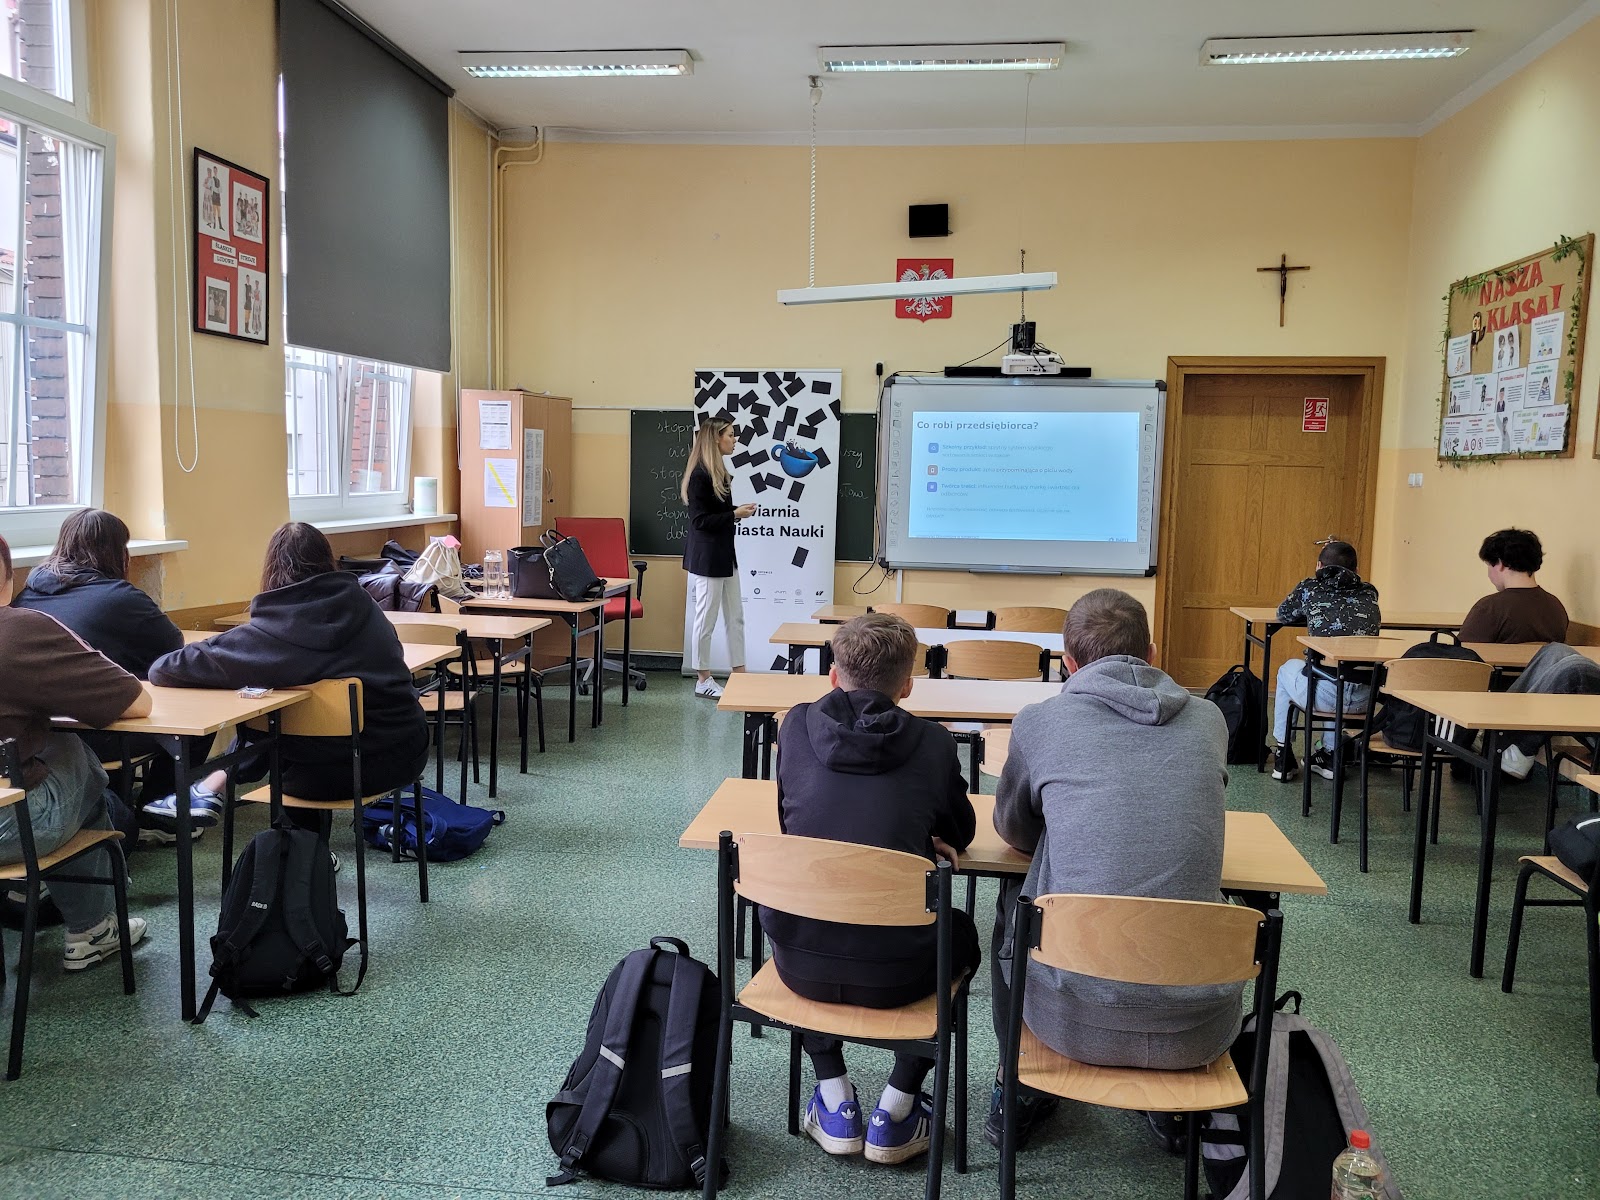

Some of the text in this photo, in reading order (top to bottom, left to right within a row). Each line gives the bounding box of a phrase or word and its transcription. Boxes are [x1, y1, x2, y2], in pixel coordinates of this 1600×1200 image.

[1478, 260, 1543, 307] NASZA
[917, 421, 1039, 432] Co robi przedsiębiorca?
[780, 525, 824, 537] Nauki
